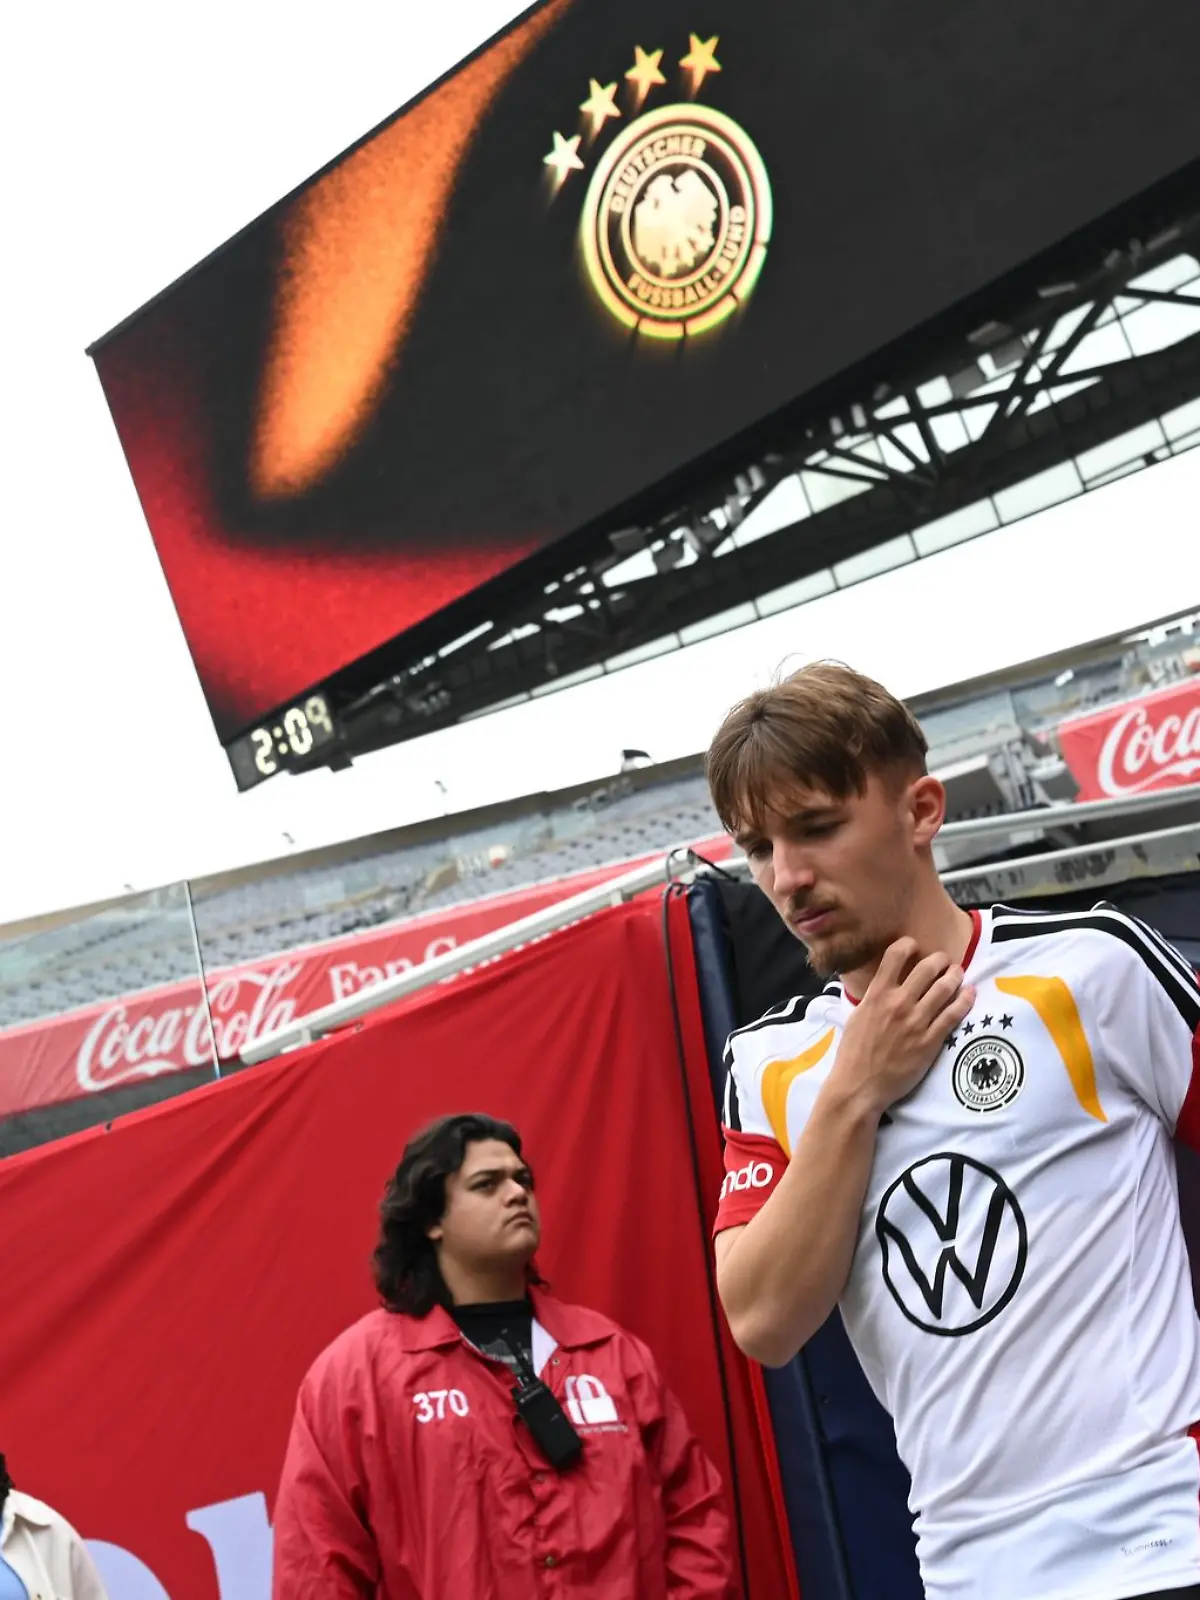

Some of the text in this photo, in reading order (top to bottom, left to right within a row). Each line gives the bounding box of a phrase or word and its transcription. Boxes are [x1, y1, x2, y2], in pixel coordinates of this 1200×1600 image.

[609, 134, 707, 214] DEUTSCHER
[250, 695, 333, 775] 2:09
[412, 1388, 470, 1424] 370
